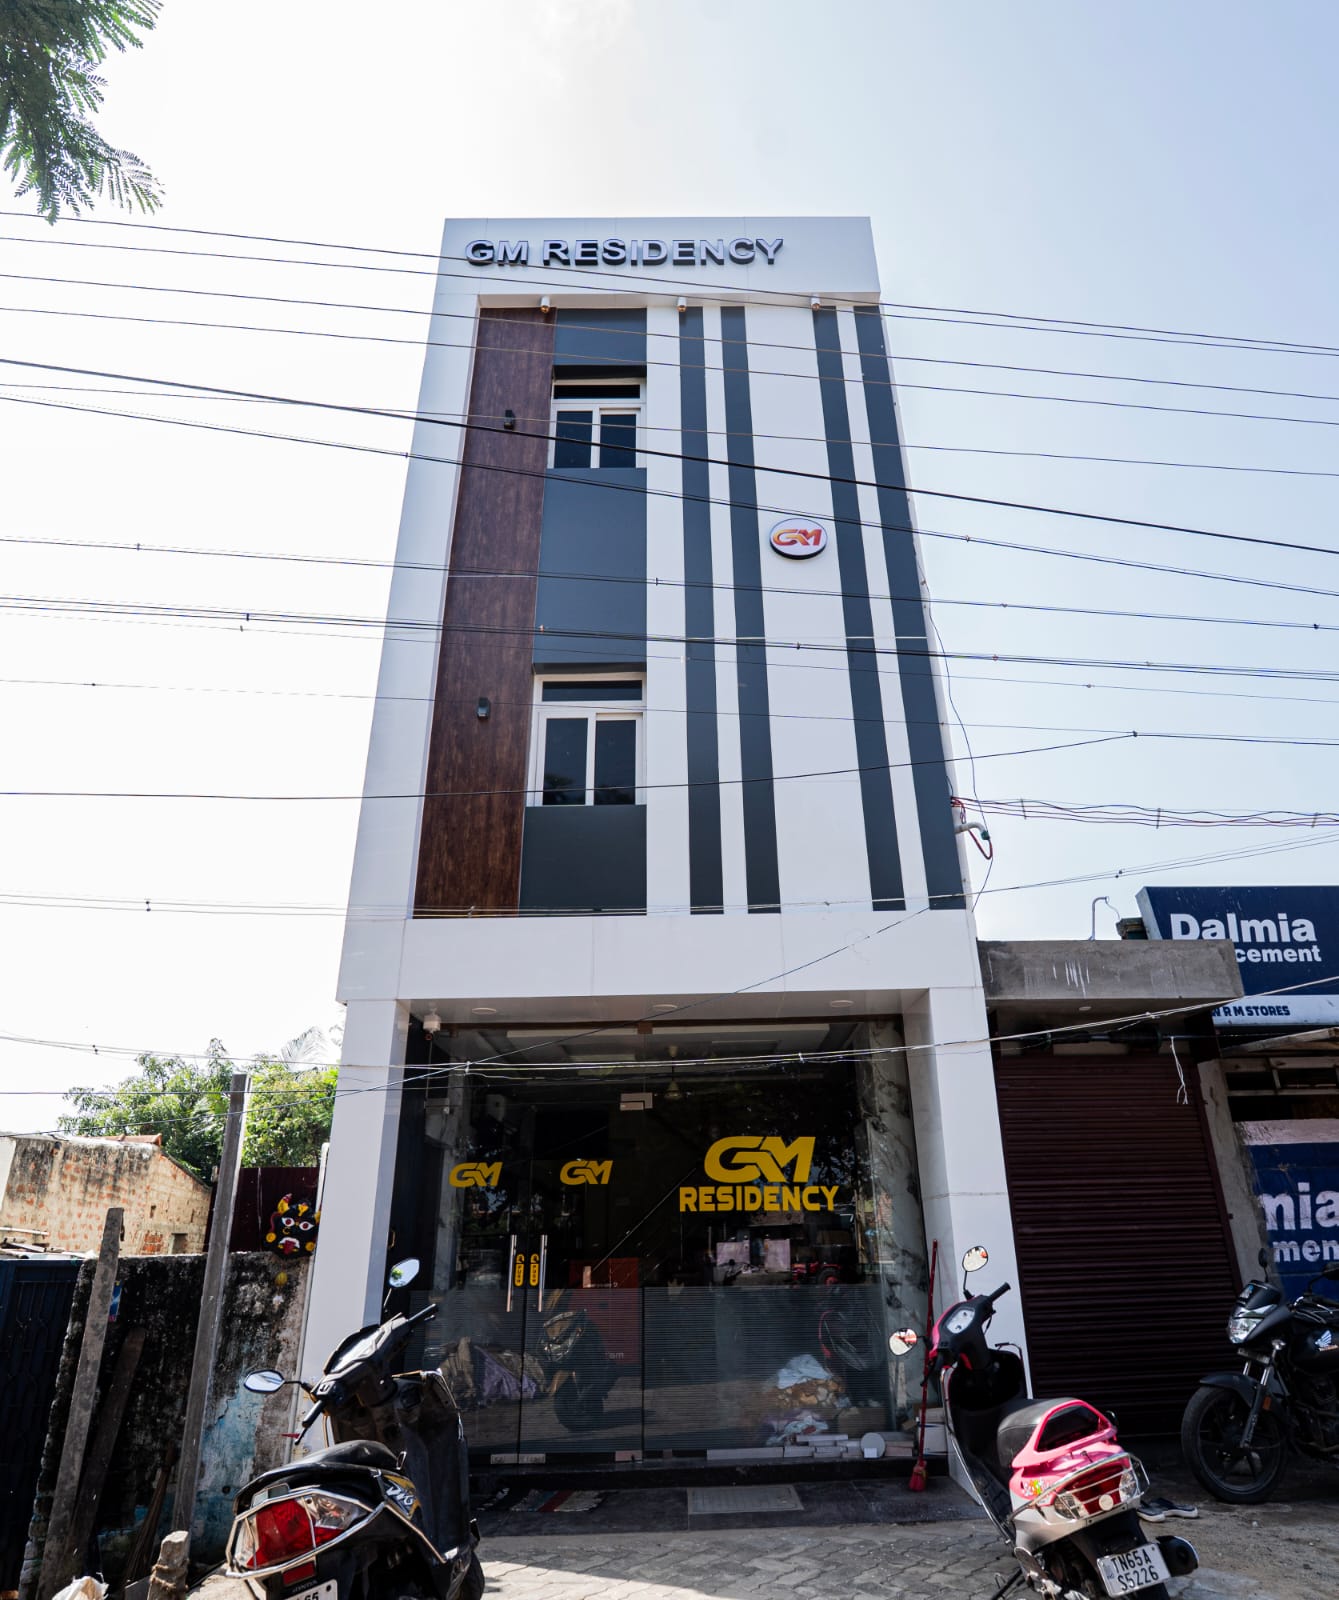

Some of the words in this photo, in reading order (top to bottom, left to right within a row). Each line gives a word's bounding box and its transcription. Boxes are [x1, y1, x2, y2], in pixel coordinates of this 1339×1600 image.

[465, 239, 529, 265] GM
[542, 238, 784, 265] RESIDENCY
[772, 528, 822, 546] GM
[1170, 913, 1317, 943] Dalmia
[1236, 945, 1322, 963] cement
[1233, 1005, 1245, 1017] M
[1245, 1005, 1291, 1017] STORES
[704, 1135, 815, 1183] GM
[449, 1161, 503, 1188] GM
[559, 1160, 613, 1185] GM
[679, 1185, 839, 1213] RESIDENCY
[1110, 1549, 1152, 1574] TN65A
[1117, 1565, 1159, 1591] S5226
